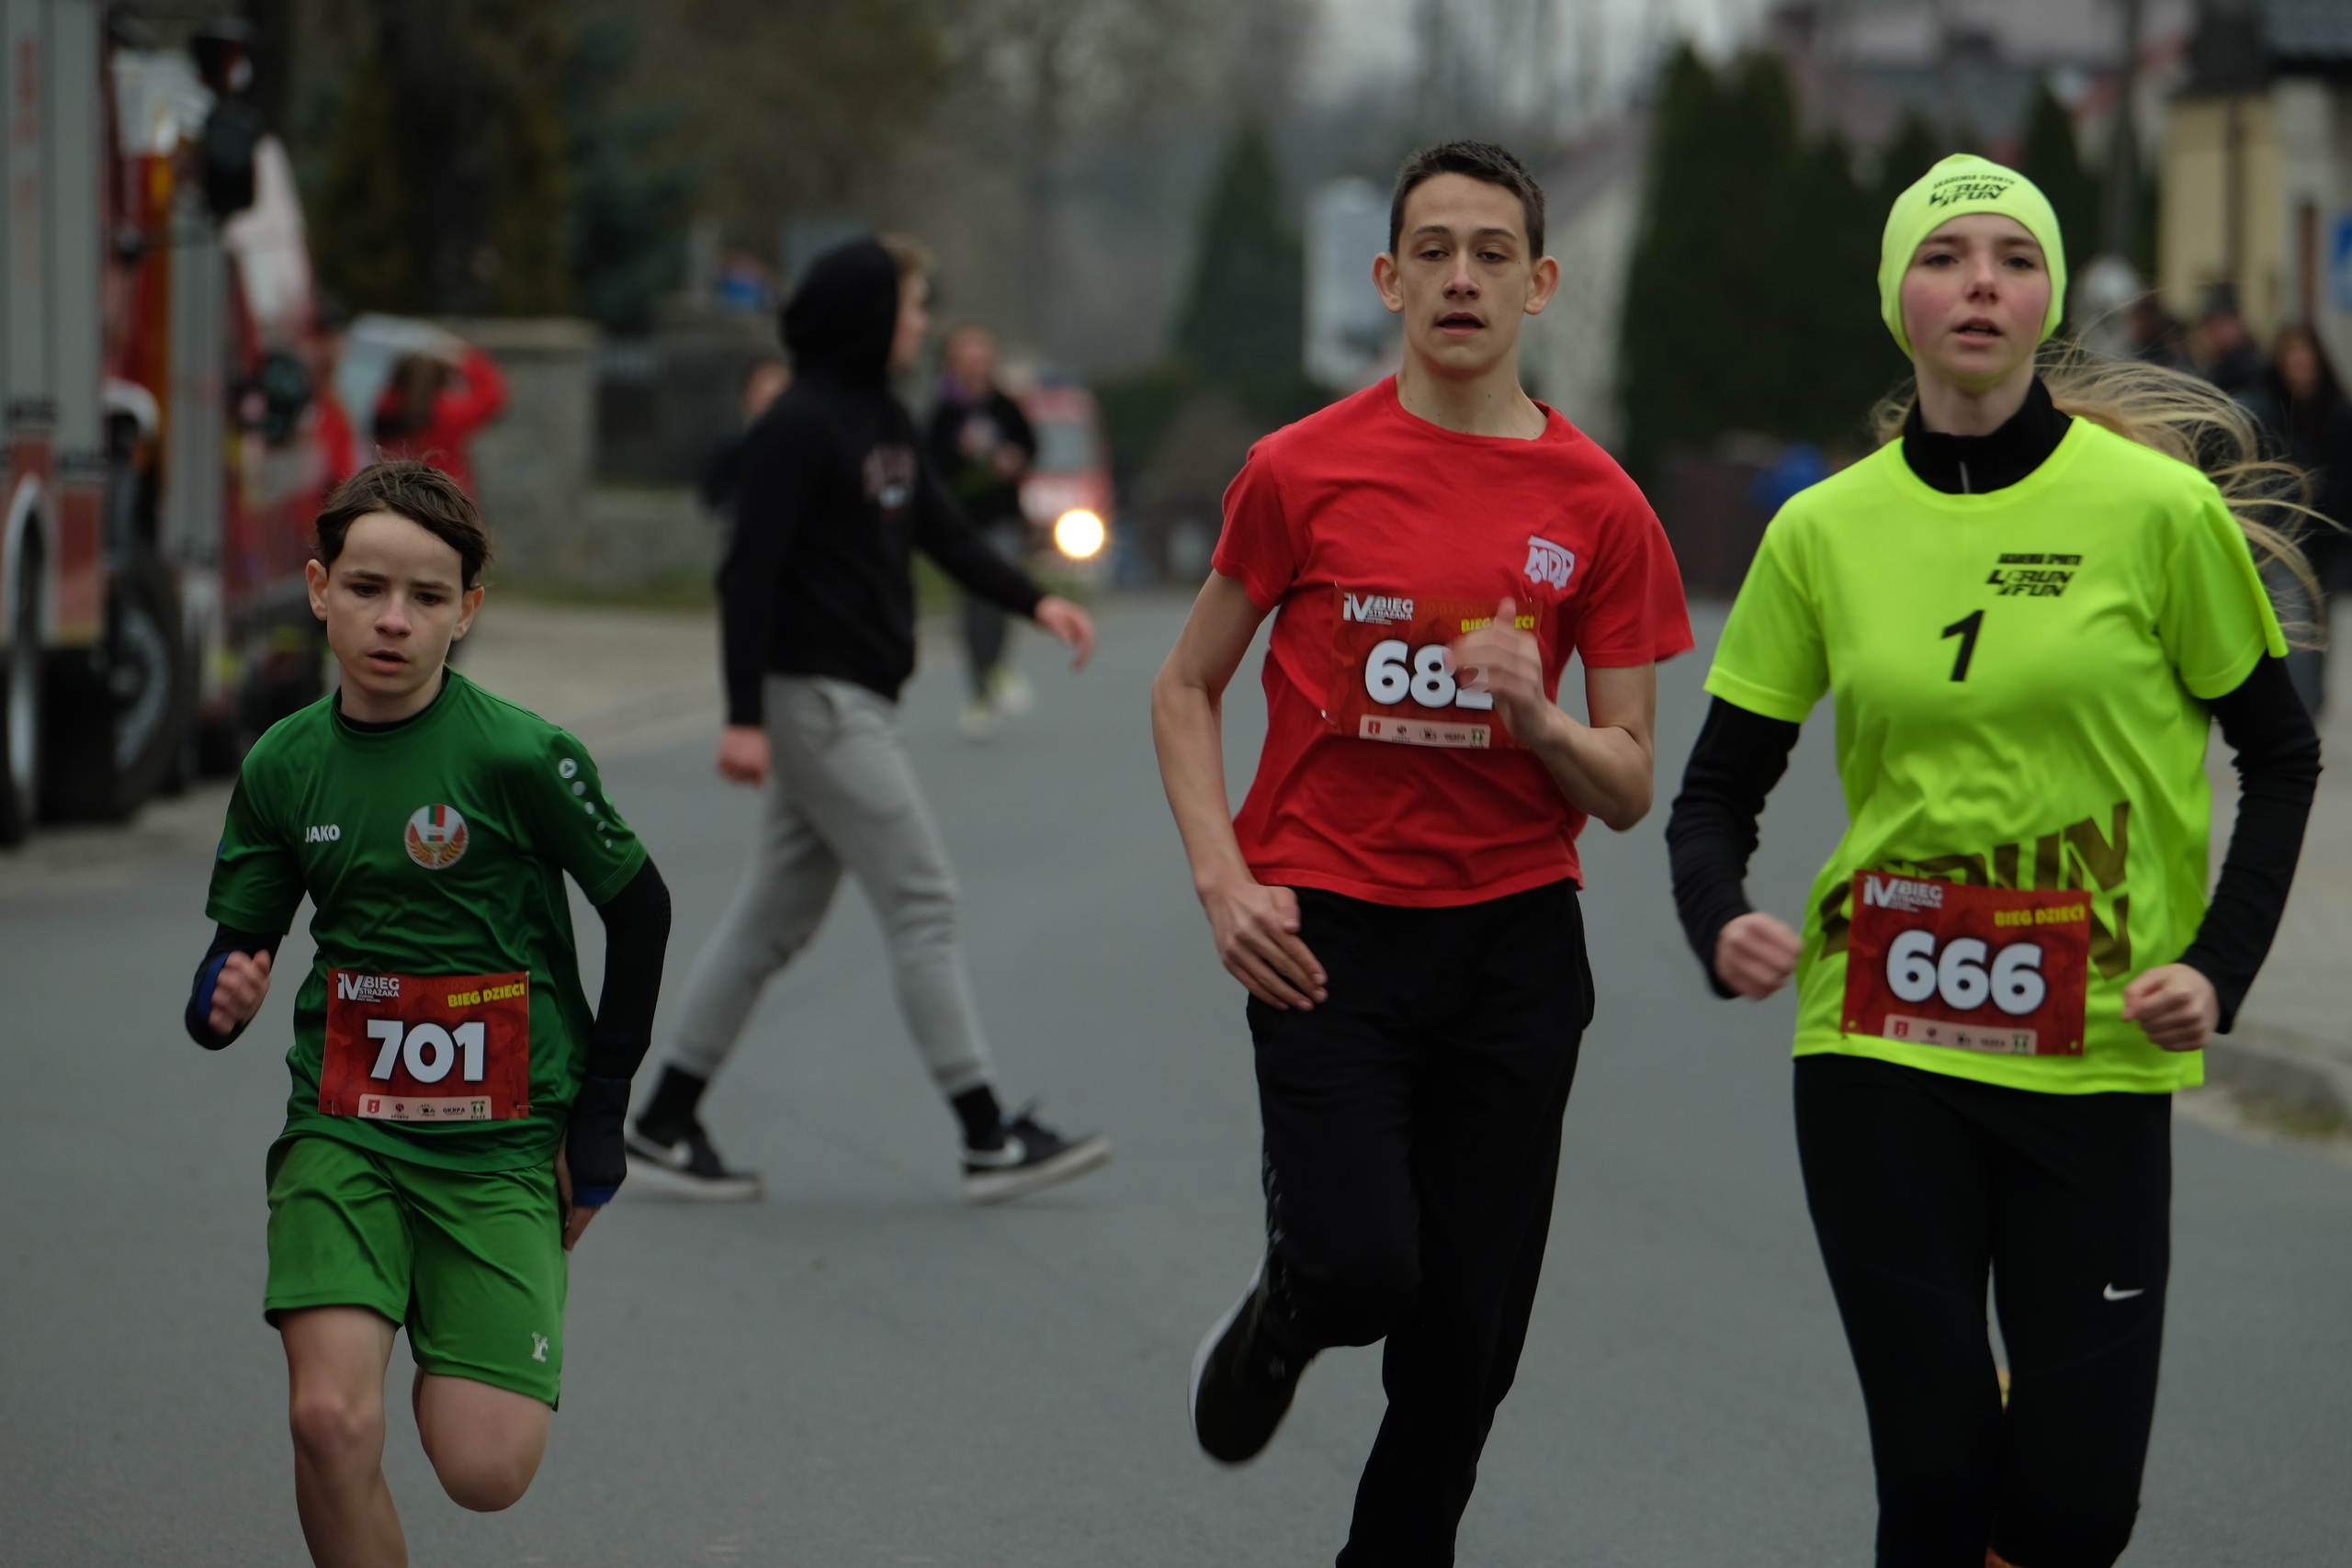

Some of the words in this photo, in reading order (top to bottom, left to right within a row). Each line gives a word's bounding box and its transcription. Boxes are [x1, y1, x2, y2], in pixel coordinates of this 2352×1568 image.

[1374, 595, 1414, 614] BIEG
[1461, 617, 1493, 633] BIEG
[1940, 609, 1985, 682] 1
[304, 824, 340, 843] JAKO
[1863, 874, 1899, 908] IV
[1897, 879, 1943, 900] BIEG
[1994, 909, 2033, 927] BIEG
[2035, 904, 2086, 924] DZIECI
[363, 976, 400, 991] BIEG
[1886, 929, 2046, 1016] 666
[338, 973, 364, 1000] IV
[358, 987, 400, 998] STRAŻAKA
[447, 990, 481, 1008] BIEG
[483, 983, 525, 1002] DZIECI
[368, 1019, 485, 1084] 701
